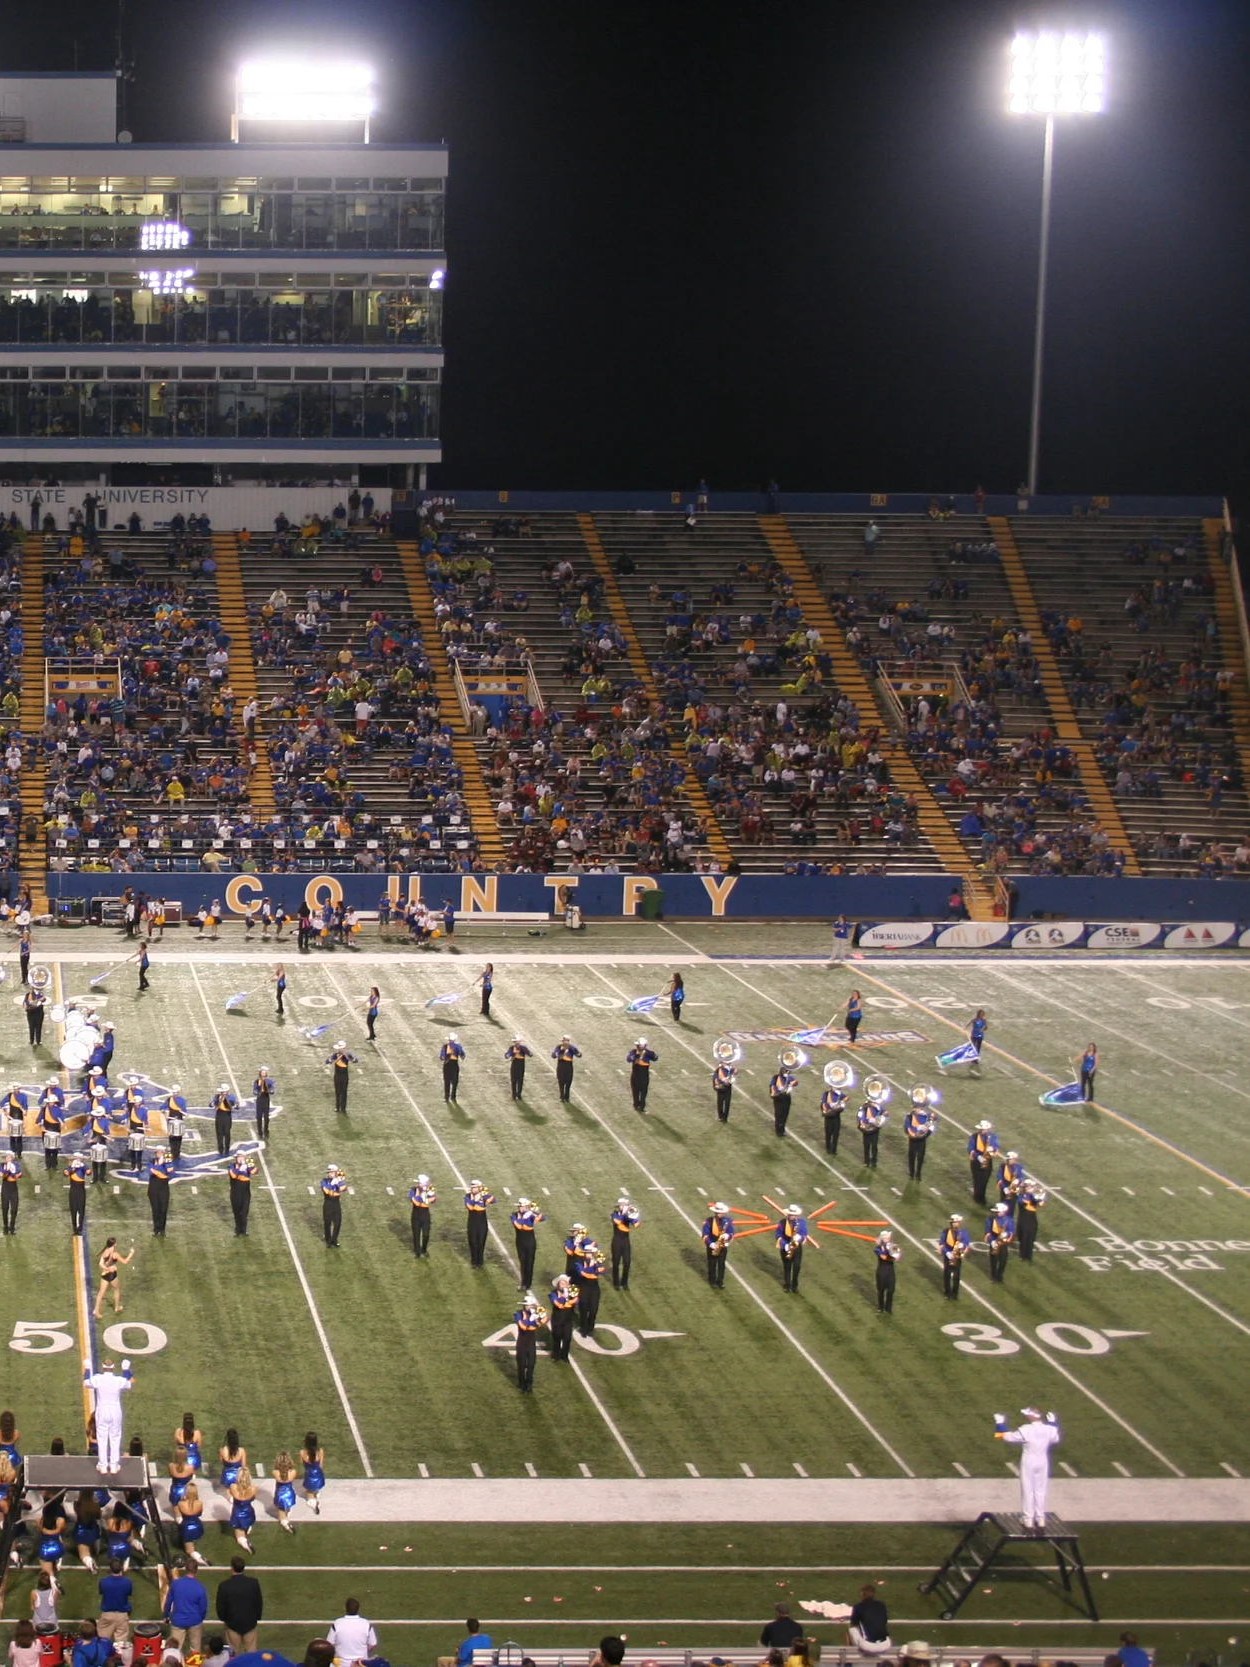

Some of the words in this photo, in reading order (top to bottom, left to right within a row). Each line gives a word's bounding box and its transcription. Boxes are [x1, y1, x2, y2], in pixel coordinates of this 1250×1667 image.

[12, 489, 66, 504] STATE
[1105, 927, 1130, 937] CSE
[1073, 1253, 1225, 1271] Field
[8, 1321, 168, 1354] 50
[940, 1322, 1112, 1356] 30
